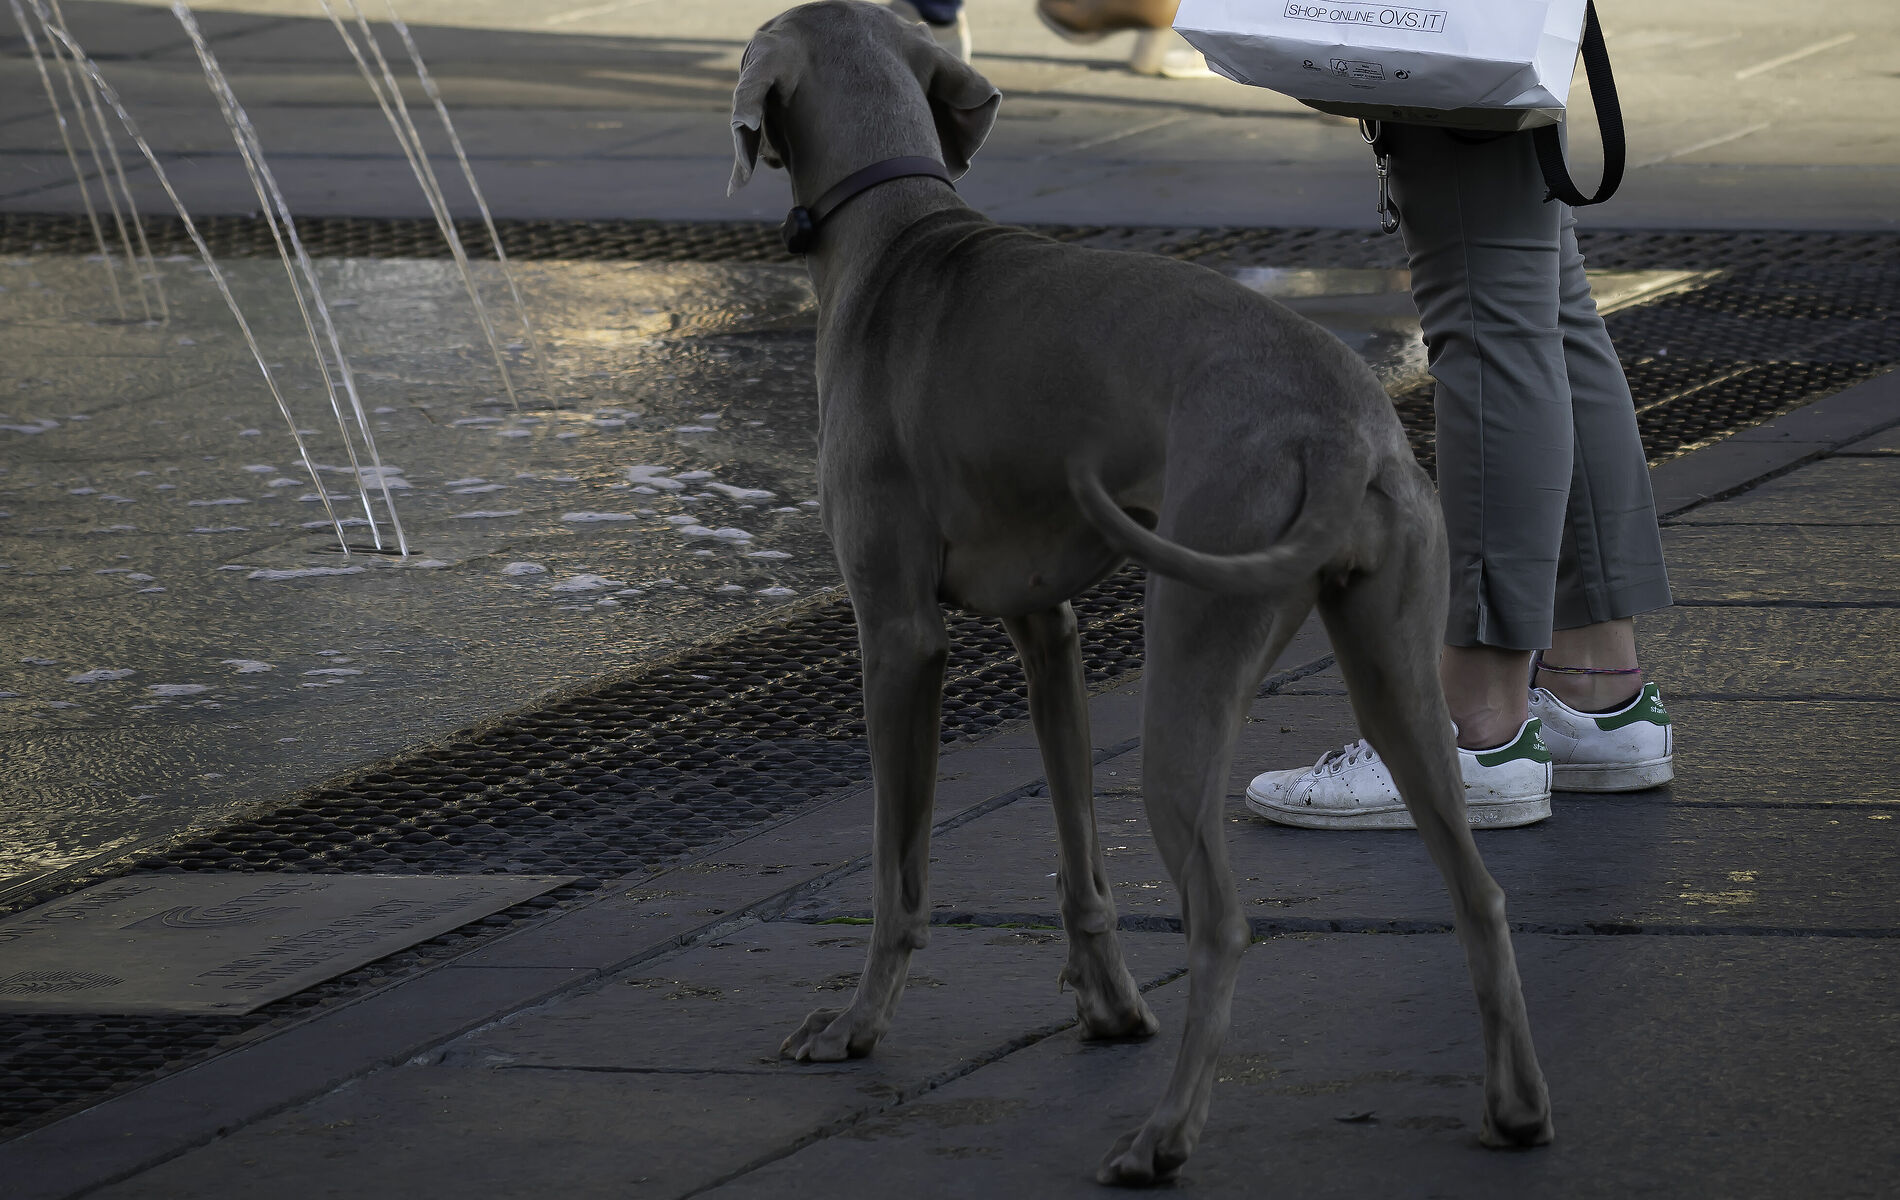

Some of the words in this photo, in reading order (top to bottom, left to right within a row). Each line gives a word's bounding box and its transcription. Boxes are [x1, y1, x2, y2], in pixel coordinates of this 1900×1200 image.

[1288, 4, 1327, 18] SHOP
[1329, 9, 1375, 23] ONLINE
[1379, 9, 1441, 29] OVS.IT
[349, 898, 425, 918] NOT
[327, 918, 375, 929] IS
[248, 928, 352, 957] WATER
[196, 958, 272, 978] THIS
[221, 951, 345, 990] SUITABLE
